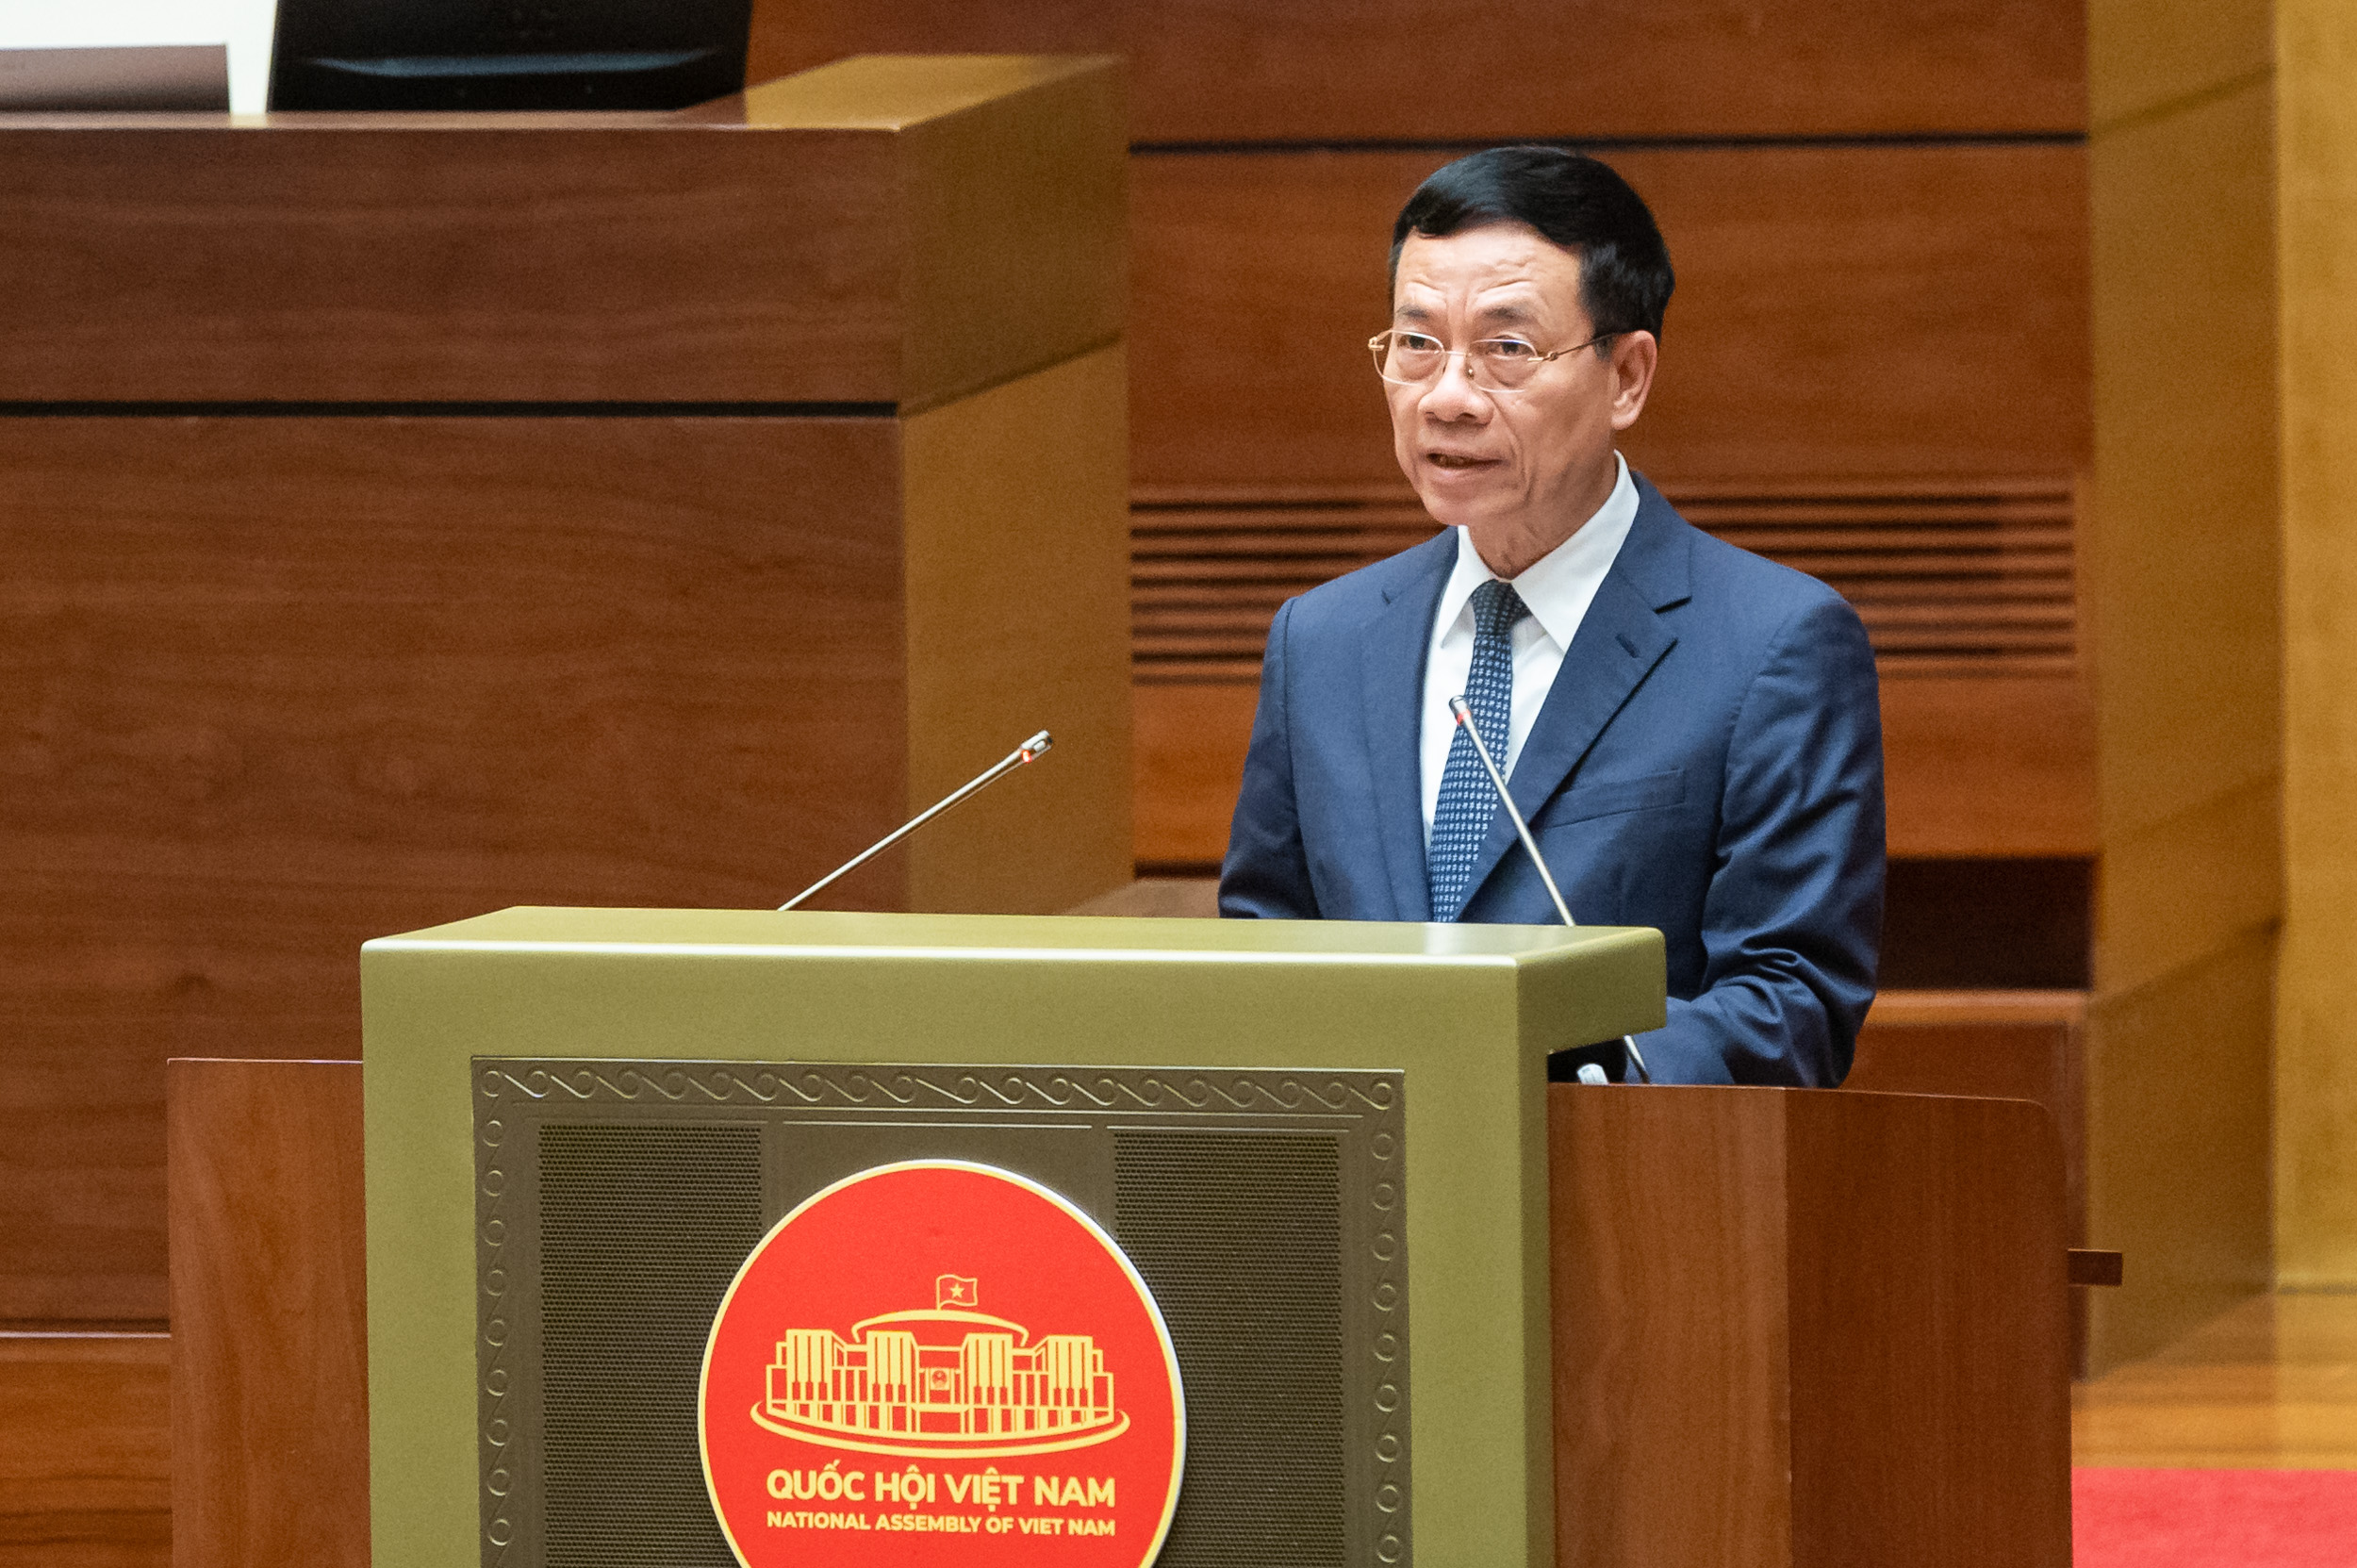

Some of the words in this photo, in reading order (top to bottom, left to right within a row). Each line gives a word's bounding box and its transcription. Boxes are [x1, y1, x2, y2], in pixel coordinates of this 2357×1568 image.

[766, 1459, 865, 1501] QUỐC
[874, 1464, 936, 1510] HỘI
[944, 1466, 1025, 1512] VIỆT
[1033, 1475, 1115, 1508] NAM
[766, 1511, 871, 1530] NATIONAL
[875, 1514, 981, 1533] ASSEMBLY
[985, 1515, 1014, 1533] OF
[1018, 1517, 1063, 1535] VIET
[1068, 1519, 1115, 1537] NAM
